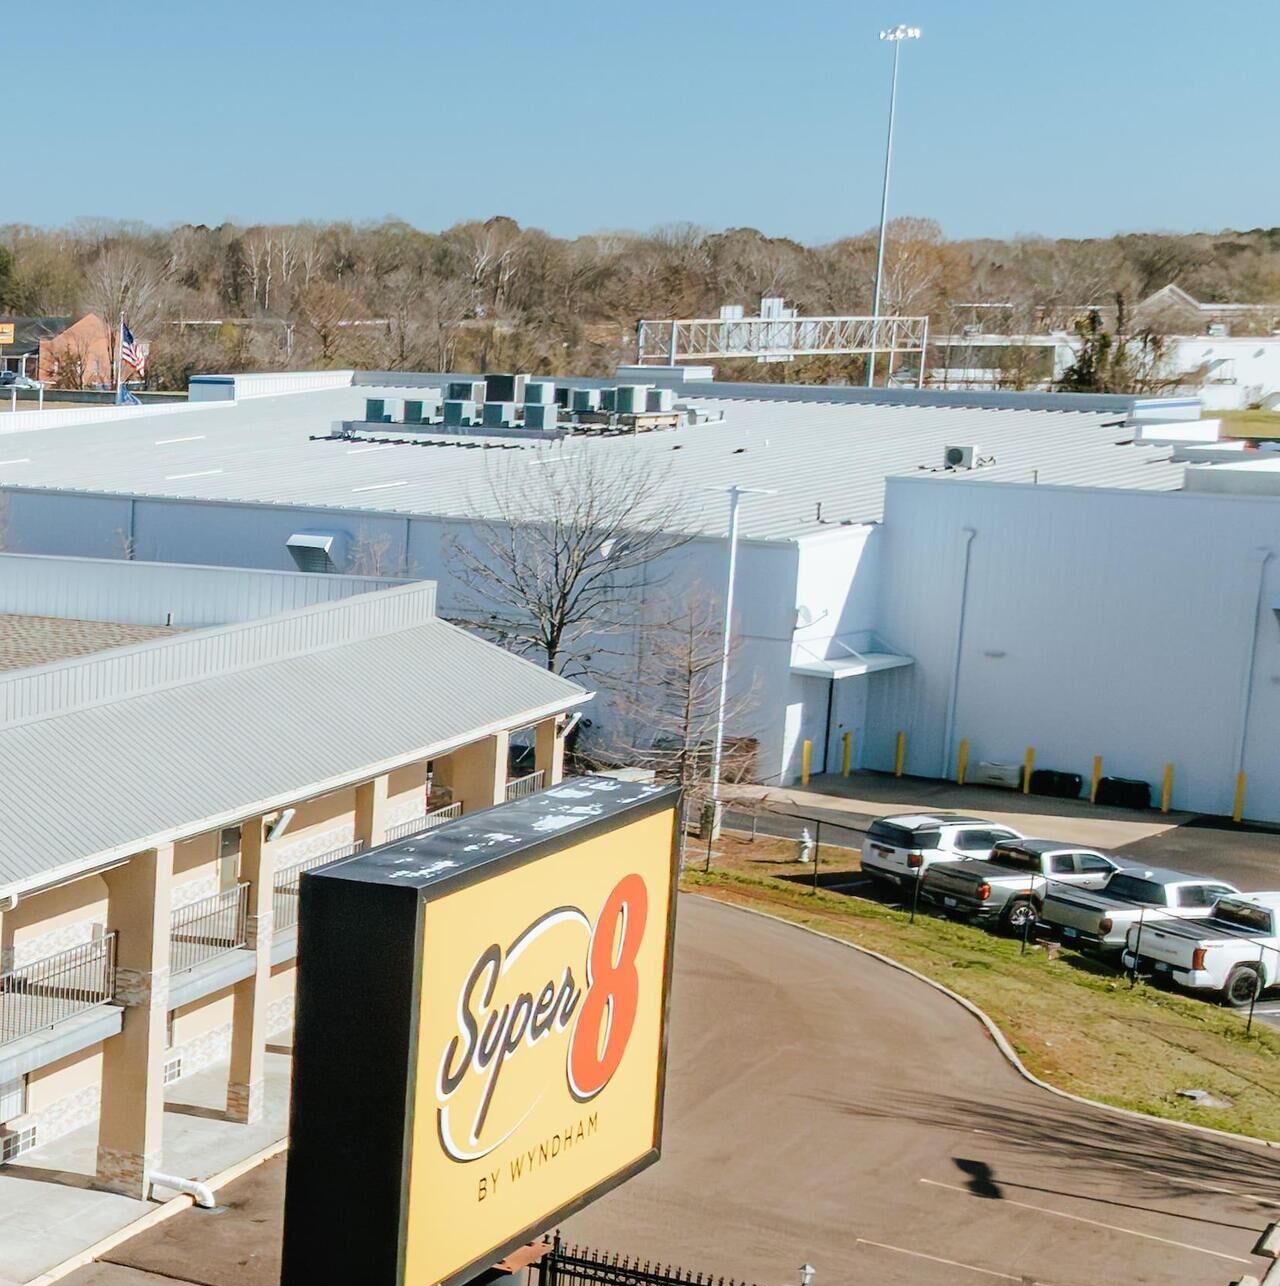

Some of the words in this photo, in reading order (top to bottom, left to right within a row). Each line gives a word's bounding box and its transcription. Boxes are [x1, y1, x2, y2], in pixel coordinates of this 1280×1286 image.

[438, 943, 581, 1143] Super
[567, 873, 648, 1102] 8
[478, 1168, 500, 1202] BY
[510, 1111, 598, 1182] WYNDHAM
